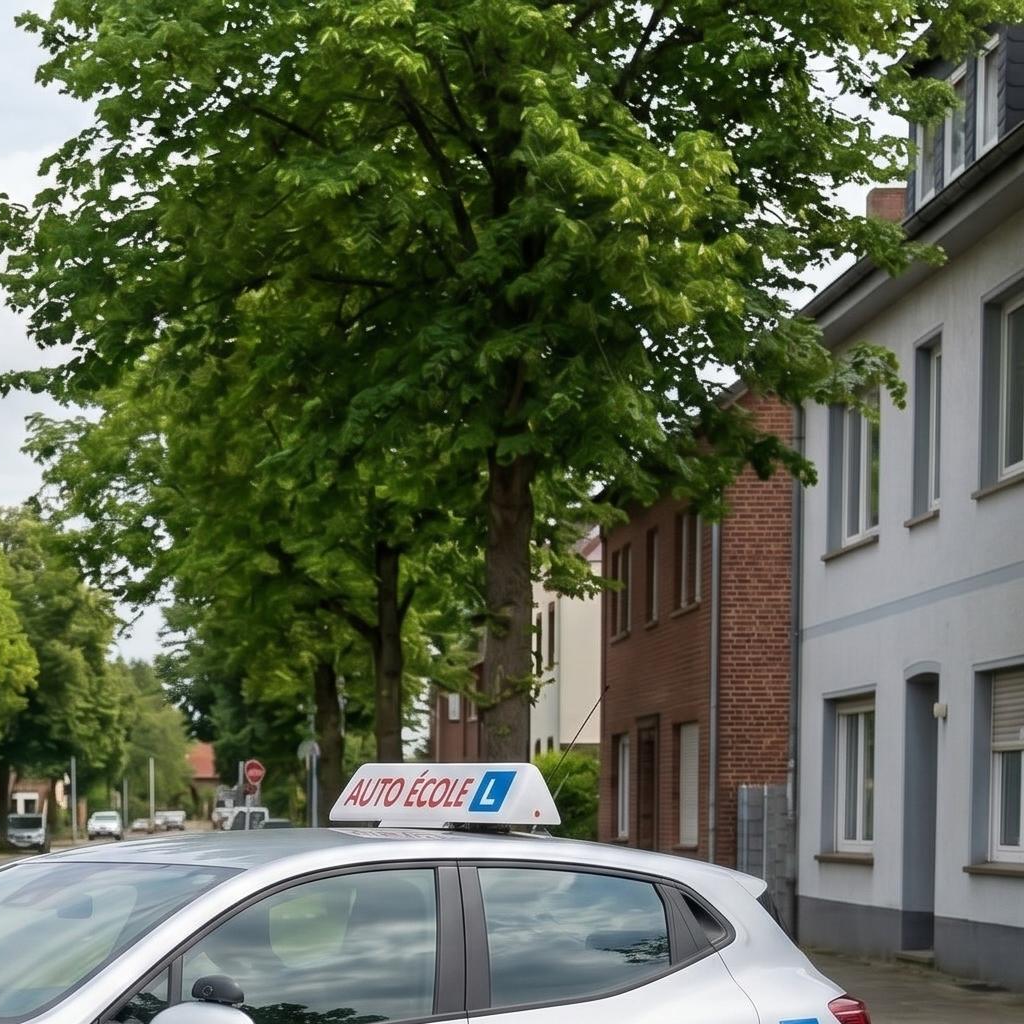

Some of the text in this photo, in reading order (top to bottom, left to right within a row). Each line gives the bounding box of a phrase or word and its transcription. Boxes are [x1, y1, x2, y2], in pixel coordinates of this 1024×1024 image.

[344, 770, 496, 808] AUTO ÉCOLE L
